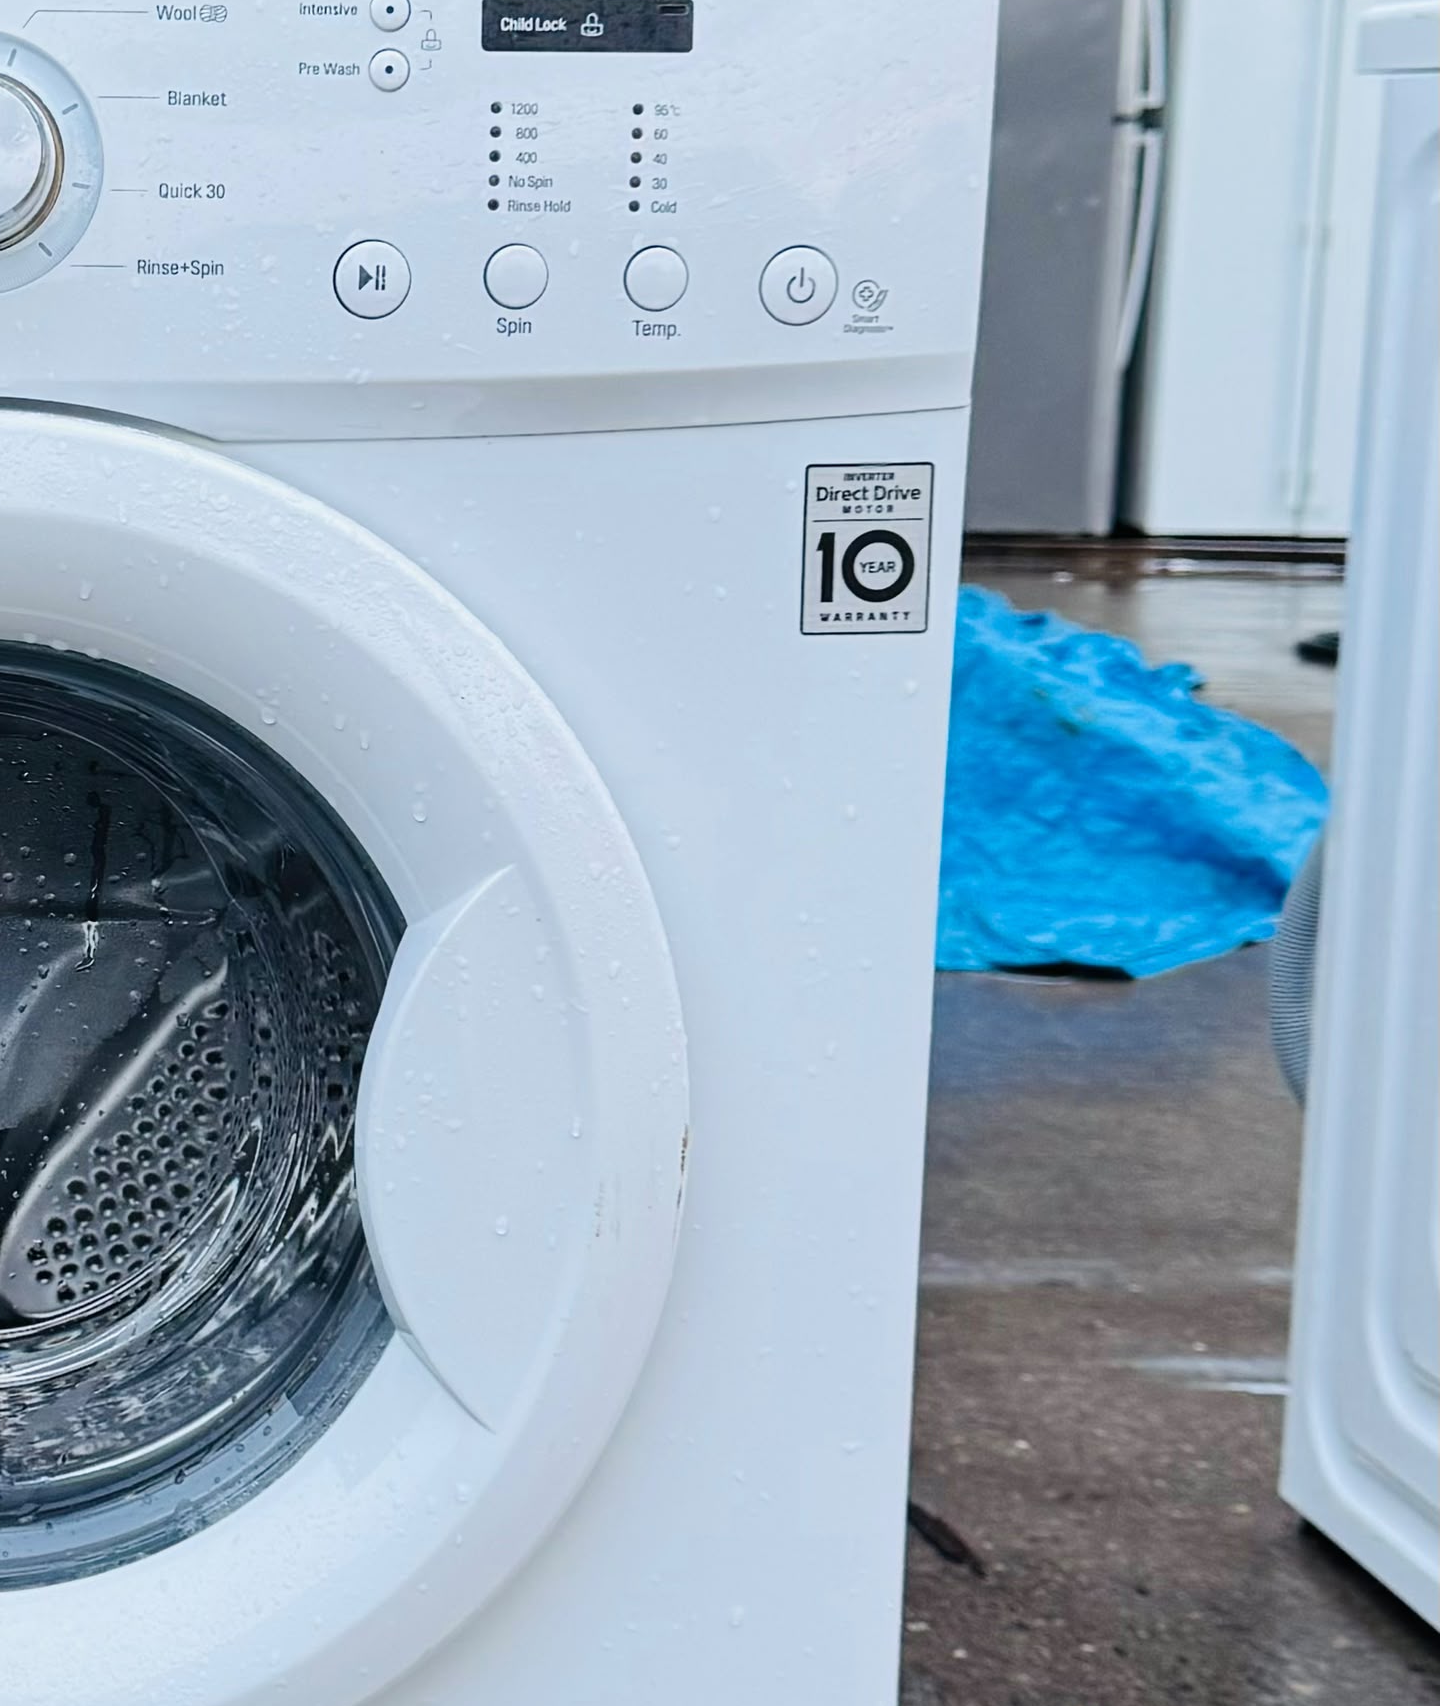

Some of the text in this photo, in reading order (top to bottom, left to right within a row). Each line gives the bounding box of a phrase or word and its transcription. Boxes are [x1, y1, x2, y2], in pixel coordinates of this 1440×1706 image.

[157, 4, 197, 22] Wool
[500, 16, 568, 32] Child Lock
[298, 62, 360, 76] Pre Wash
[167, 90, 227, 107] Blanket
[511, 103, 539, 116] 1200
[515, 127, 538, 140] 800
[515, 152, 538, 164] 400
[652, 153, 668, 165] 40
[509, 176, 553, 190] No Spin
[651, 178, 668, 190] 30
[158, 182, 226, 201] Quick 30
[507, 200, 571, 213] Rinse Hold
[650, 201, 678, 214] Cold
[137, 258, 225, 278] Rinse+Spin
[496, 317, 532, 337] Spin
[632, 320, 681, 340] Temp.
[816, 485, 921, 502] Direct Drive
[842, 504, 894, 514] MOTOR
[816, 529, 915, 603] 10
[860, 561, 896, 573] YEAR
[820, 611, 911, 622] WARRANTY
